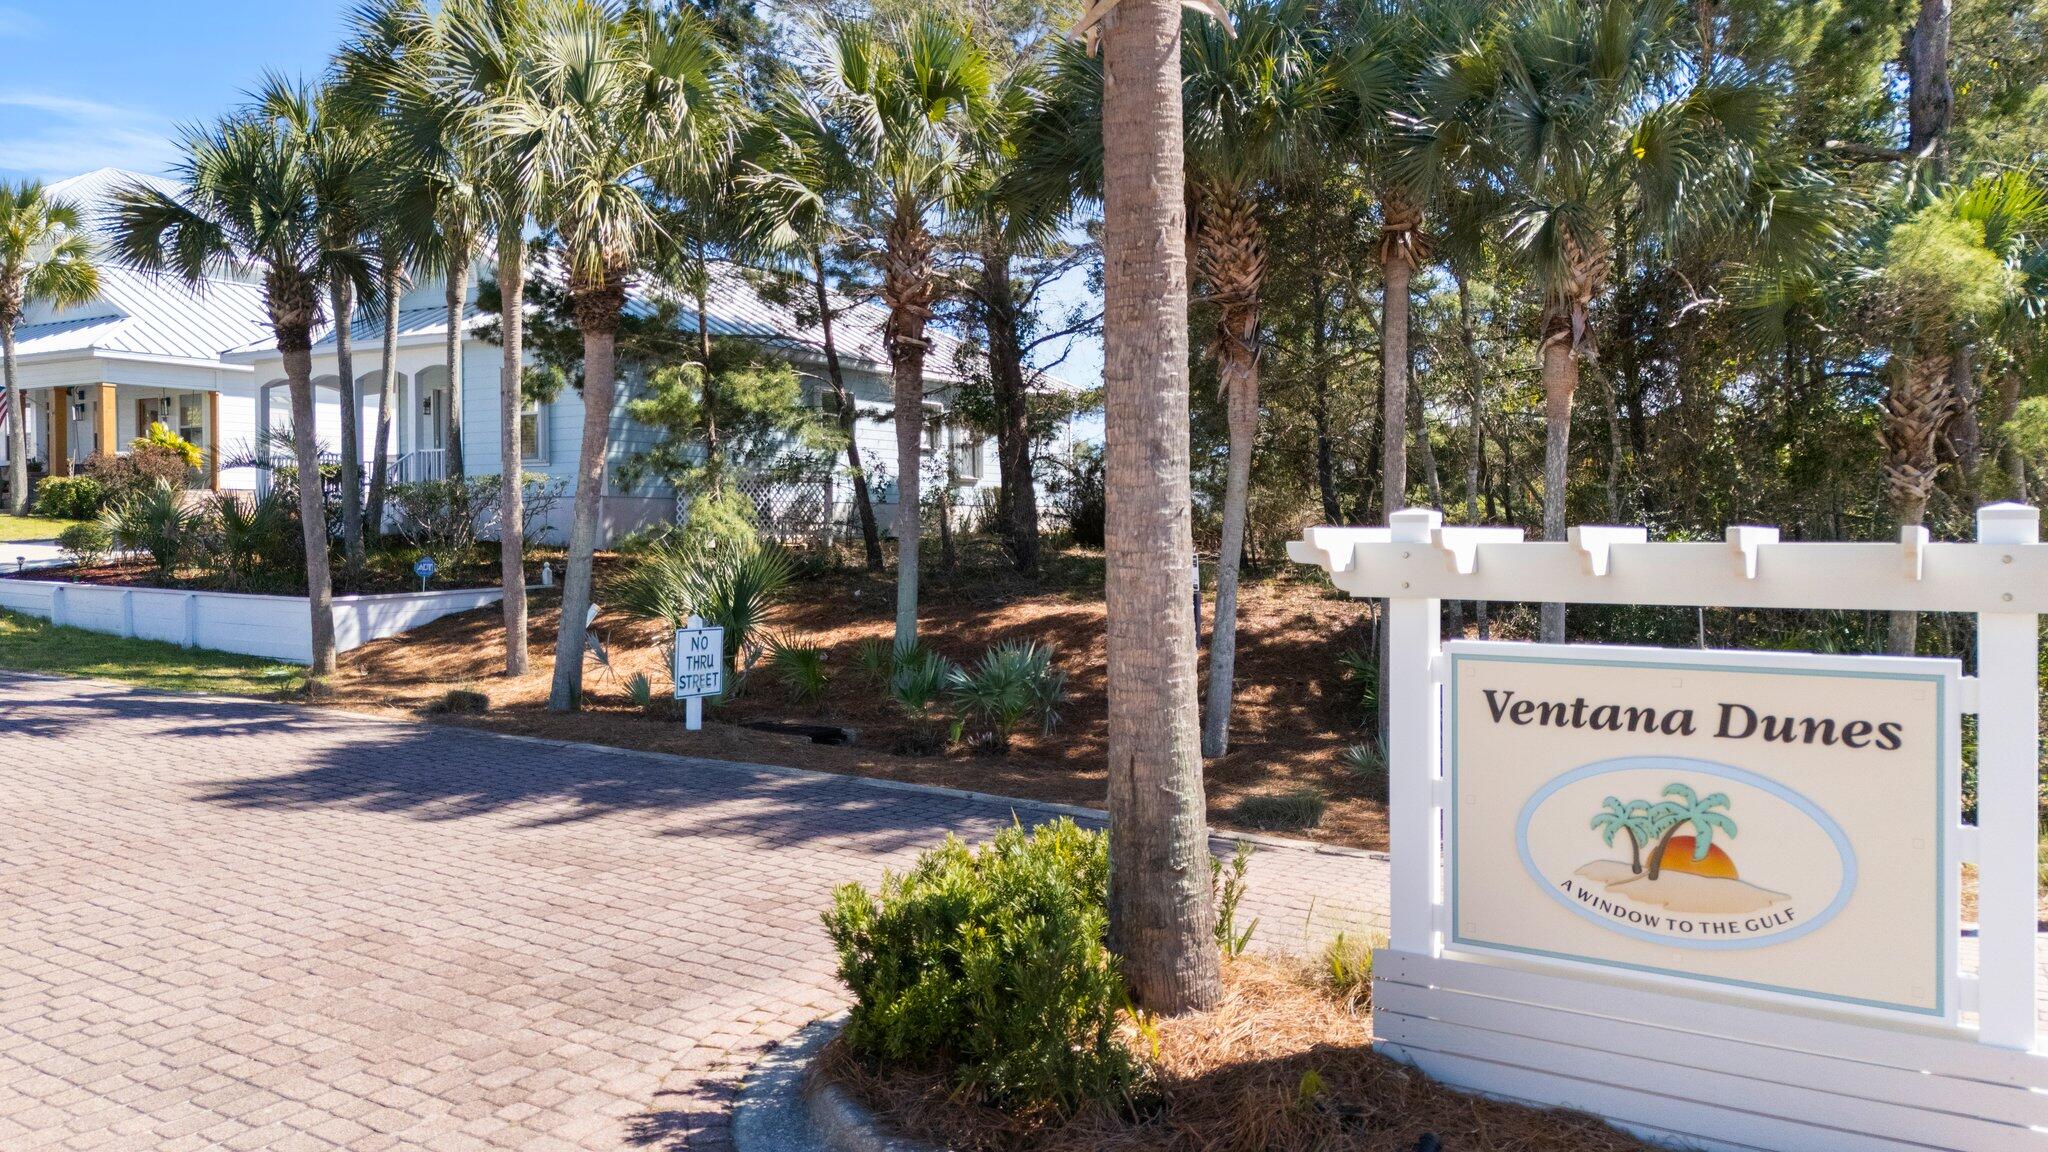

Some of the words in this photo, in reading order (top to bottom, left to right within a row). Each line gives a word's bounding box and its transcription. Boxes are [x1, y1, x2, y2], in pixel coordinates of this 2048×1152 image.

[417, 563, 433, 571] ADT
[691, 636, 709, 651] NO
[686, 654, 714, 671] THRU
[679, 672, 719, 690] STREET
[1482, 689, 1696, 736] Ventana
[1713, 702, 1904, 751] Dunes
[1561, 879, 1573, 892] A
[1577, 887, 1660, 928] WINDOW
[1665, 918, 1693, 933] TO
[1699, 921, 1741, 934] THE
[1745, 907, 1795, 932] GULF
